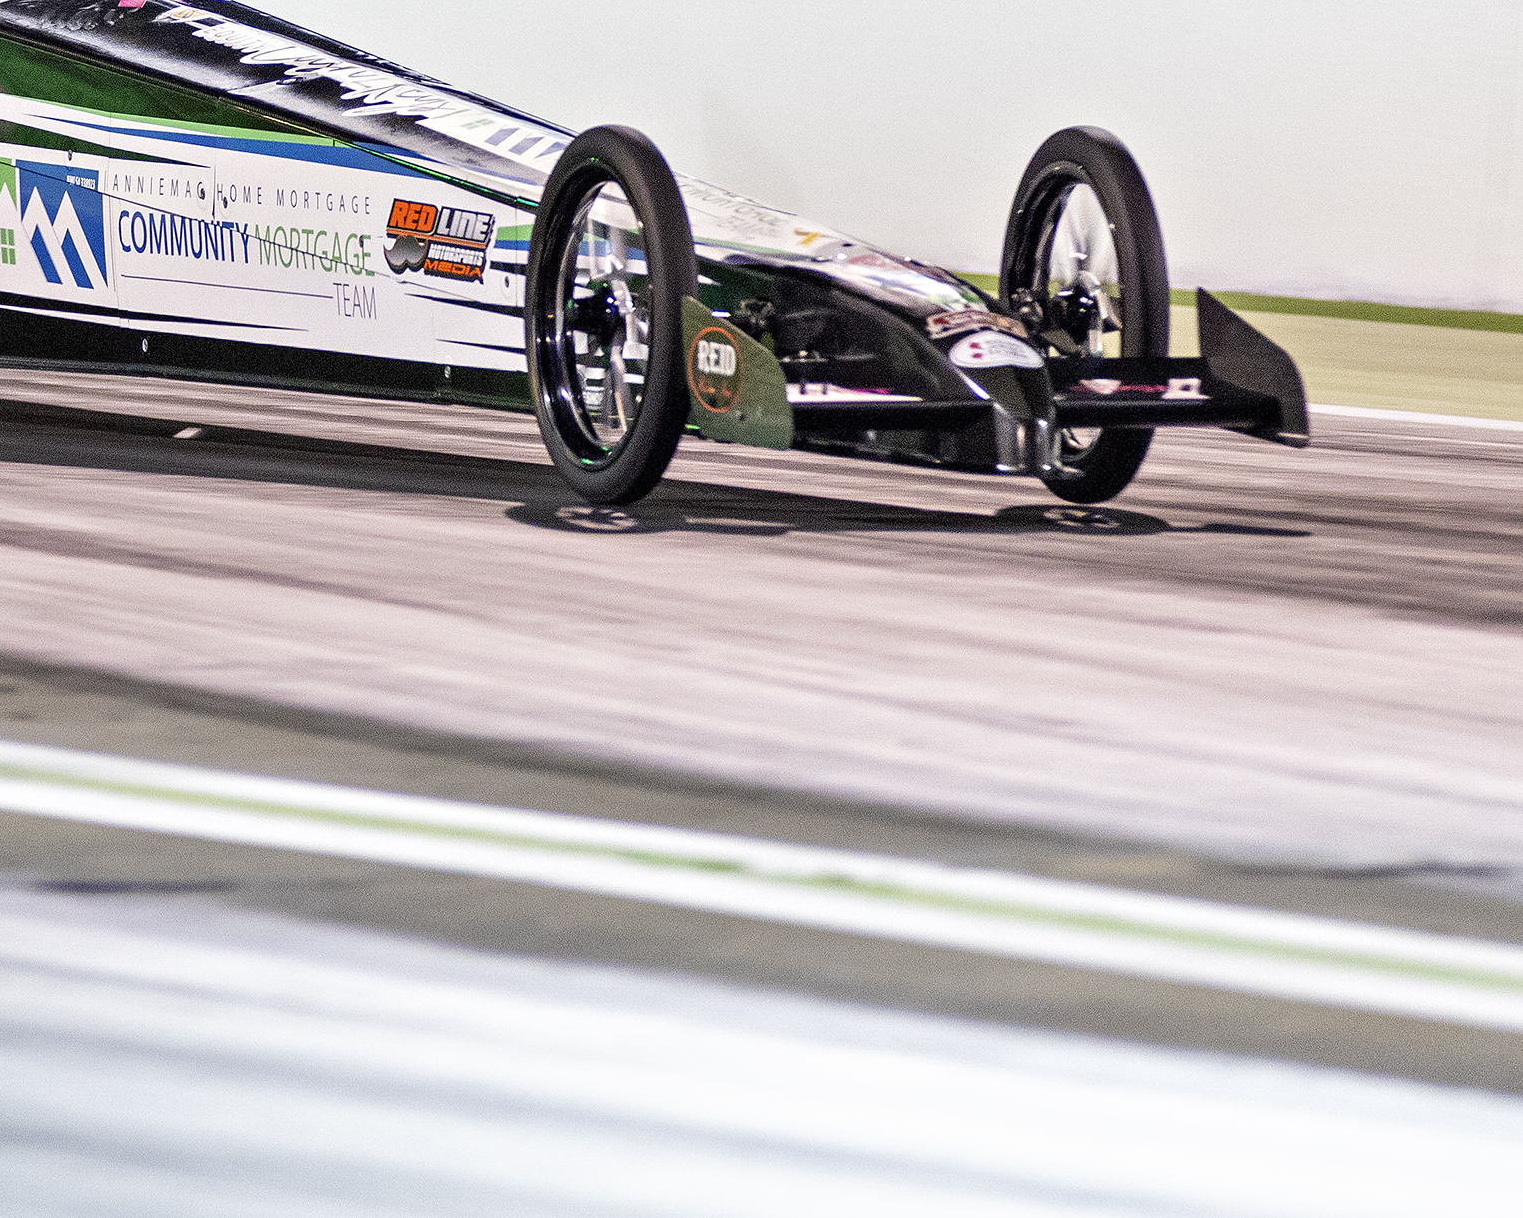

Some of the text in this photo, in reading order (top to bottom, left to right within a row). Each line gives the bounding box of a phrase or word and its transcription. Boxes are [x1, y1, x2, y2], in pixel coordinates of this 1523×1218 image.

[112, 173, 205, 200] ANNIEMAC
[216, 182, 263, 205] HOME
[277, 188, 371, 215] MORTGAGE
[389, 200, 492, 242] RED LINE
[119, 210, 376, 277] COMMUNITY MORTGAGE
[424, 258, 482, 278] MEDIA
[333, 282, 377, 320] TEAM
[697, 340, 737, 377] REID
